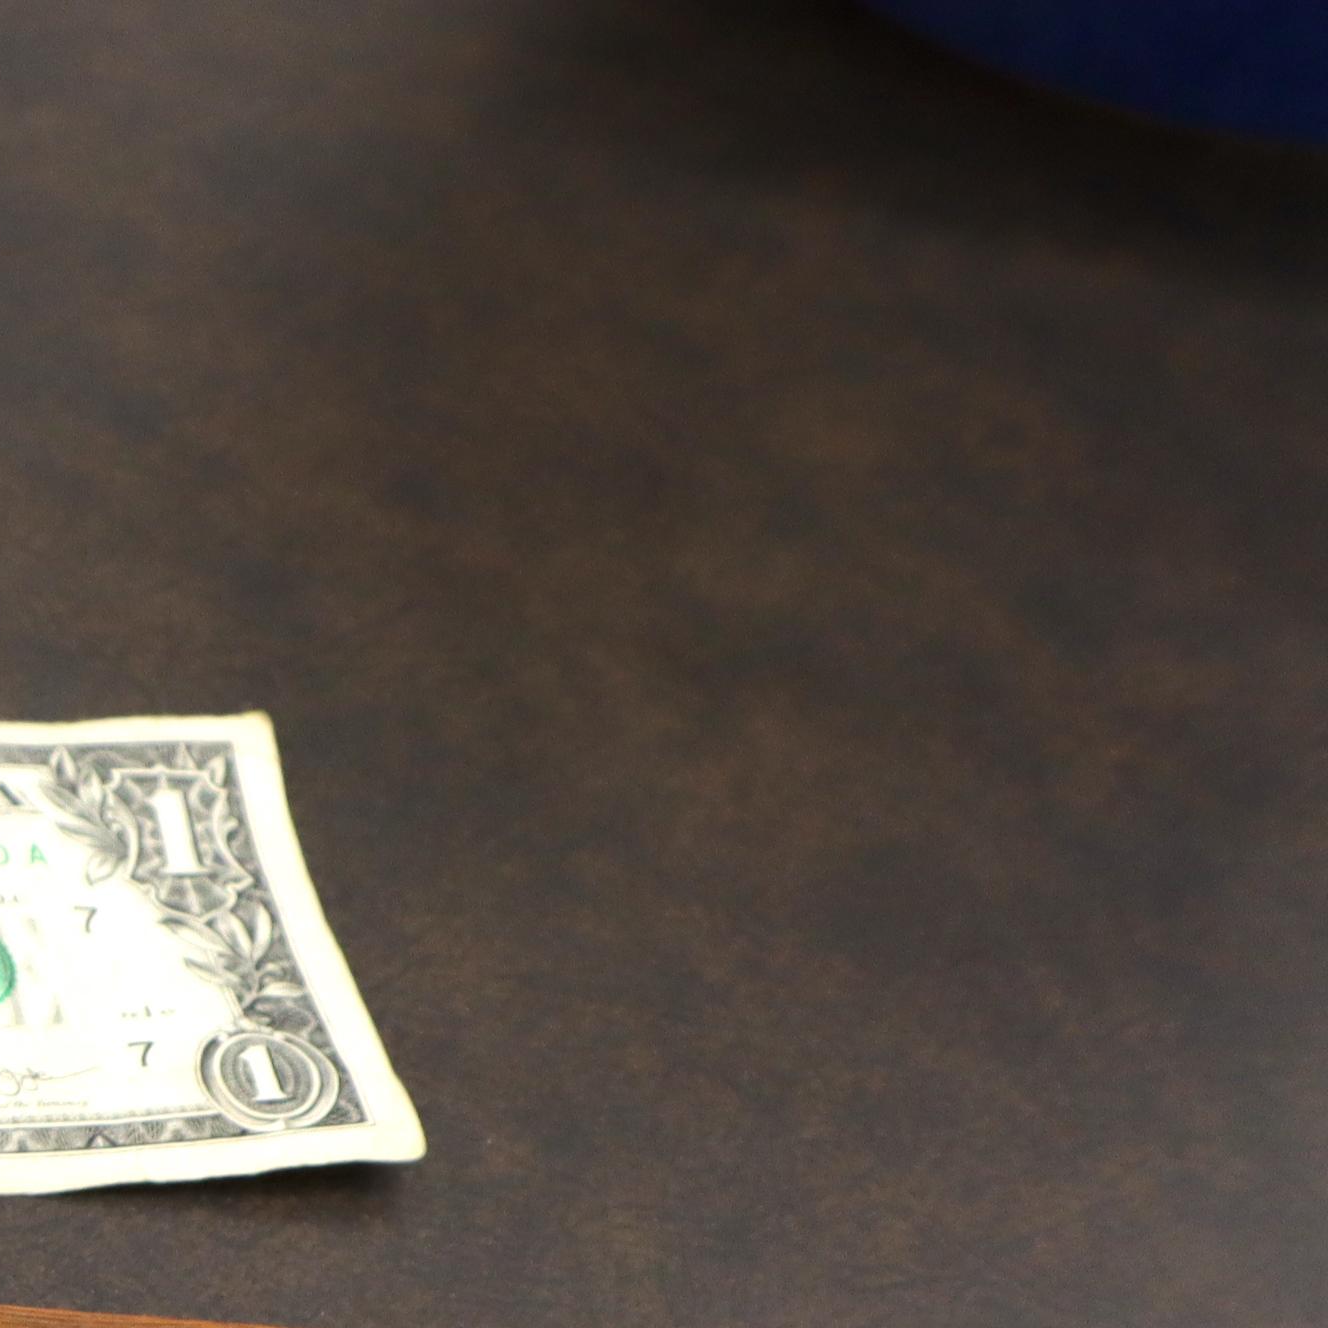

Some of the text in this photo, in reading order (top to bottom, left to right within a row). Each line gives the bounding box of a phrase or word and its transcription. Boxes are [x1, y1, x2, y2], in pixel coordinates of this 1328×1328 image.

[146, 788, 210, 876] 1
[30, 843, 48, 865] A
[74, 905, 98, 933] 7
[128, 1041, 154, 1067] 7
[238, 1044, 295, 1103] 1
